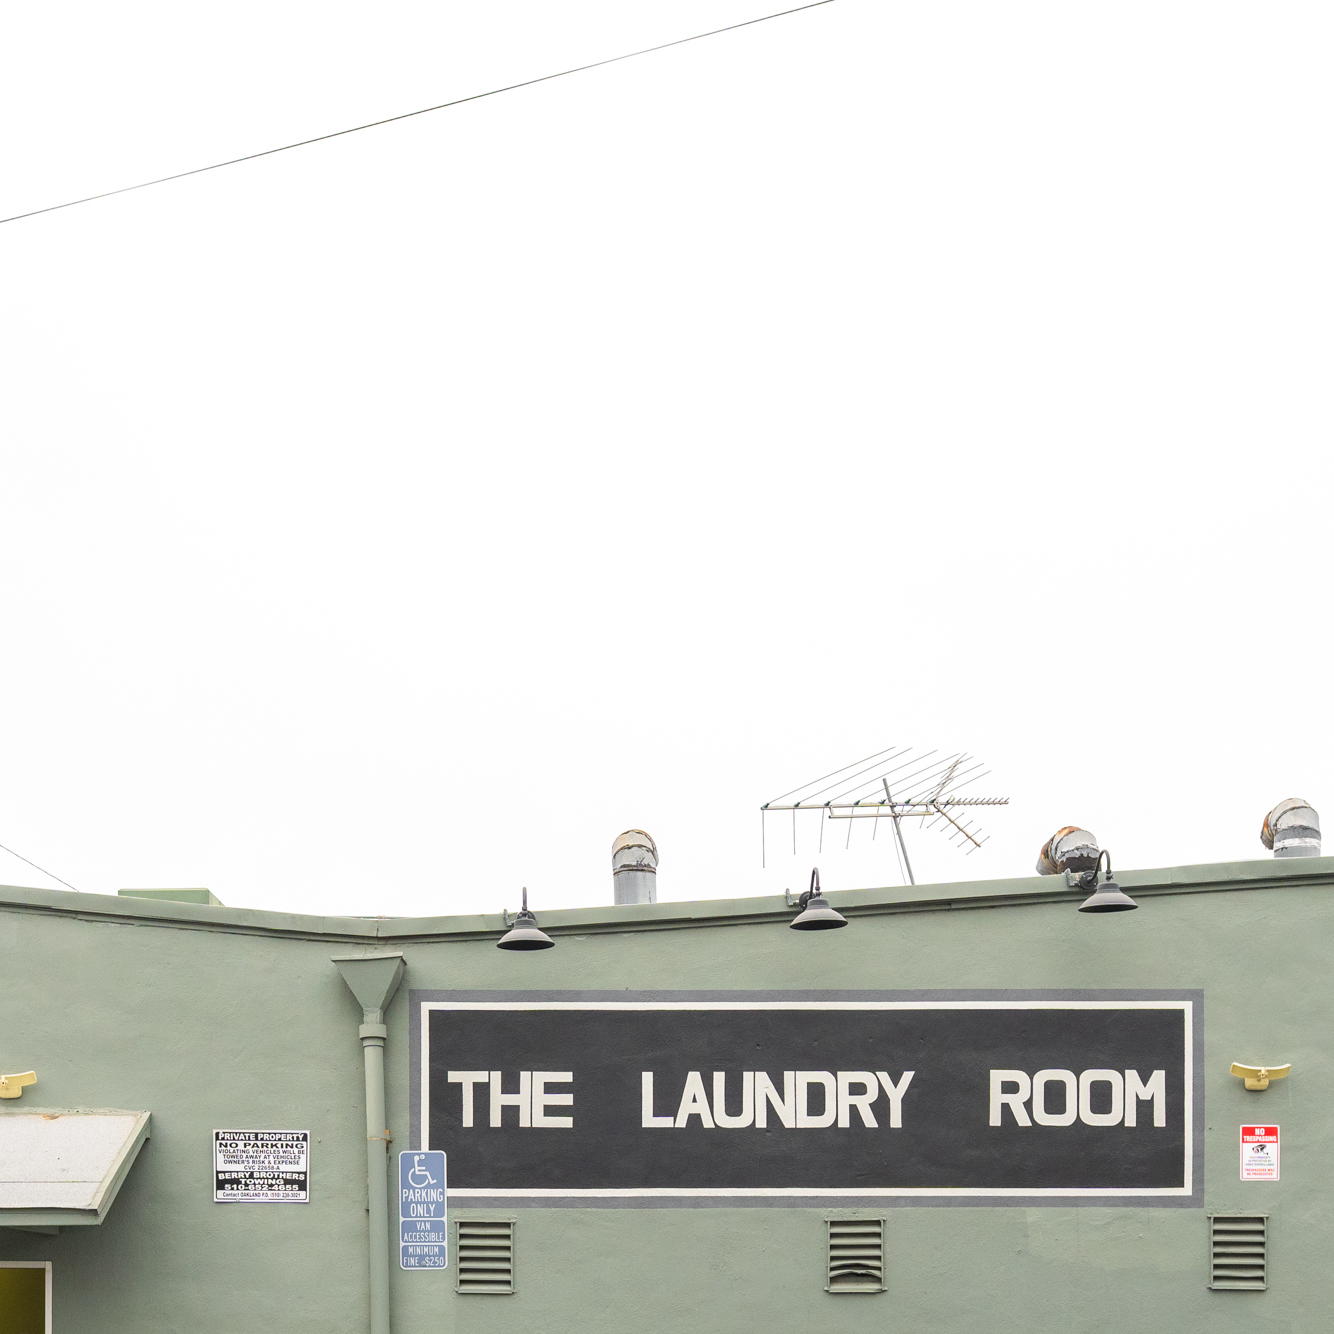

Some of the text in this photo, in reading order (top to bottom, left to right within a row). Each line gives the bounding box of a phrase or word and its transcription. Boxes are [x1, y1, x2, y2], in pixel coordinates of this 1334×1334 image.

[448, 1069, 1166, 1129] THE LAUNDRY ROOM
[254, 1172, 305, 1180] BROTHERS
[403, 1189, 443, 1202] PARKING
[410, 1204, 435, 1216] ONLY
[416, 1222, 430, 1230] VAN
[404, 1233, 443, 1241] ACCESSIBLE
[409, 1246, 438, 1255] MINIMUM
[404, 1257, 444, 1266] FINE $250
